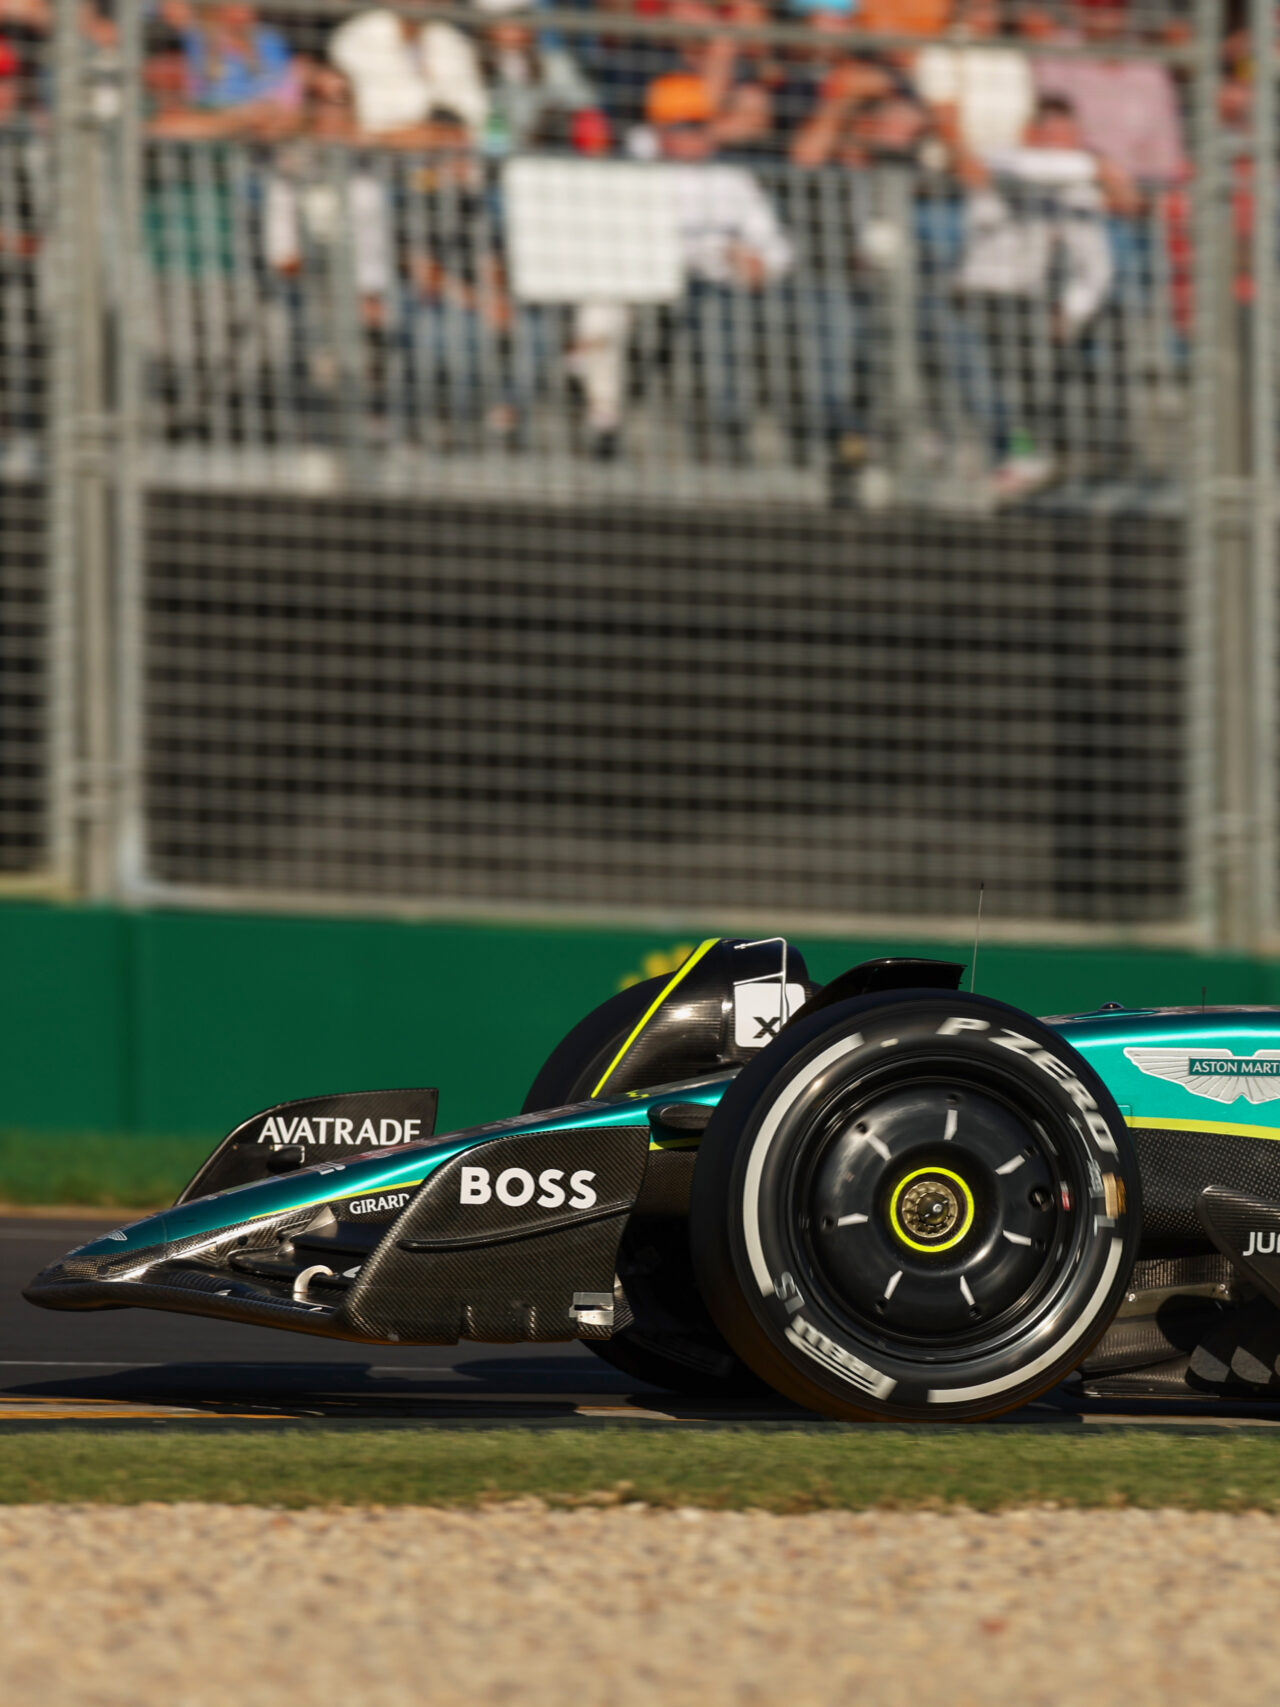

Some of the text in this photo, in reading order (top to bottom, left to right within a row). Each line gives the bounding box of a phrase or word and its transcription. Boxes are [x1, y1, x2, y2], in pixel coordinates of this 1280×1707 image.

[1192, 1060, 1238, 1074] ASTON
[935, 1017, 1119, 1155] P ZERO
[257, 1116, 422, 1146] AVATRADE
[459, 1167, 597, 1209] BOSS
